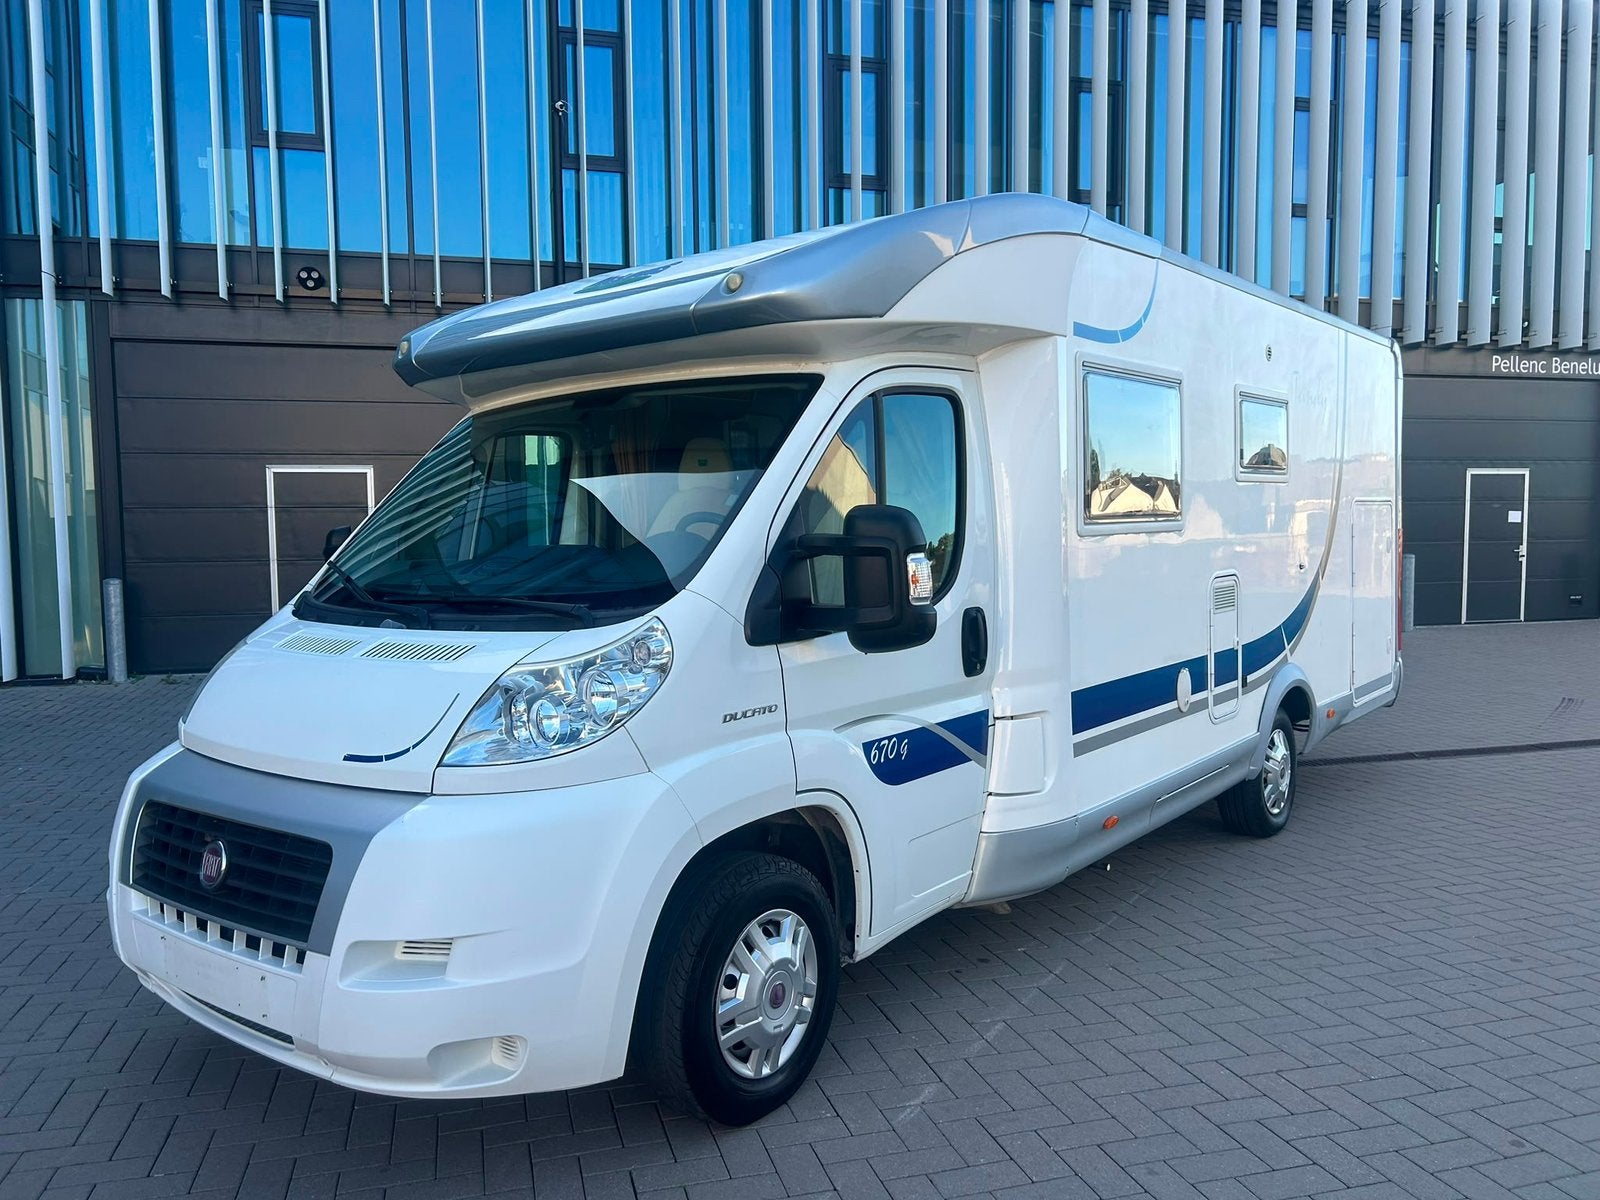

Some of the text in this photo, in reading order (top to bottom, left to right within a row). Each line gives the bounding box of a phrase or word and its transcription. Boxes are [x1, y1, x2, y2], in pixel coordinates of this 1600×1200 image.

[1492, 355, 1547, 374] Pellenc
[721, 703, 778, 724] DUCATO
[870, 737, 898, 765] 670
[203, 852, 221, 877] FIAT
